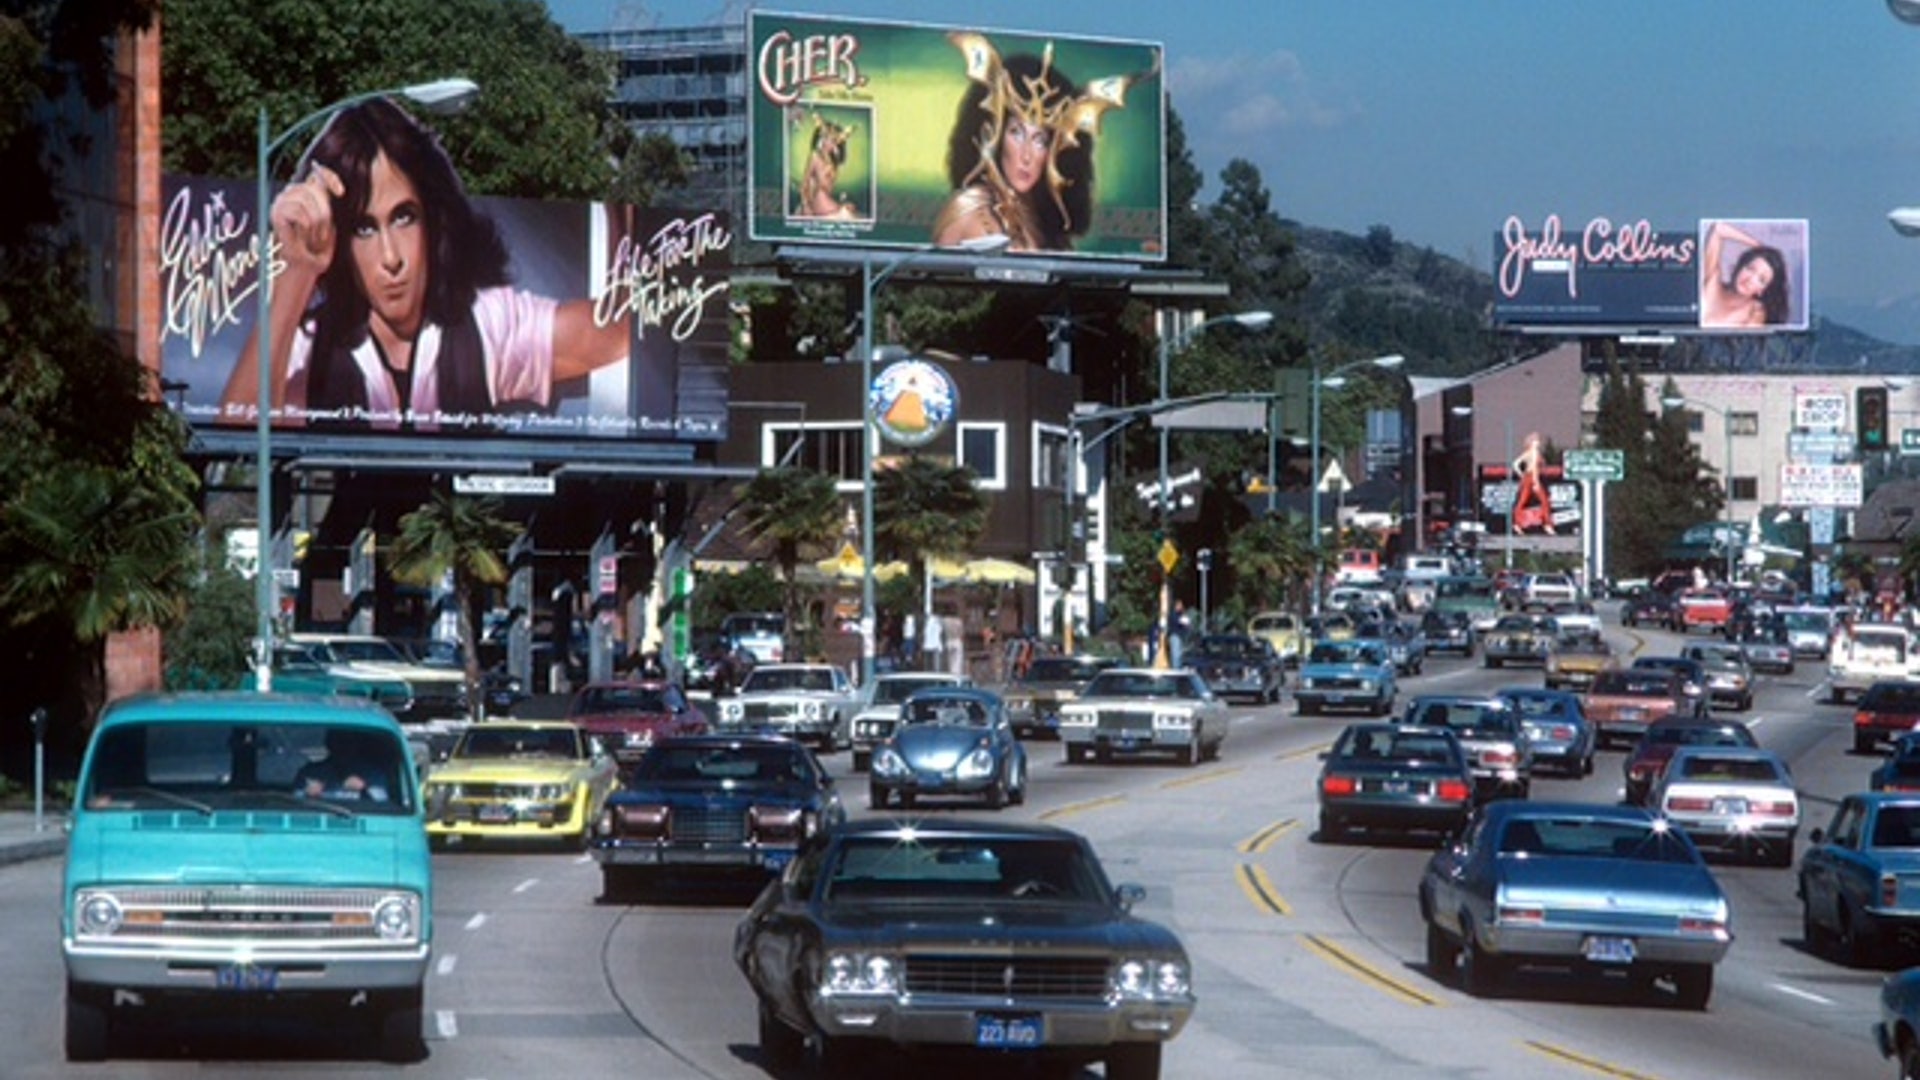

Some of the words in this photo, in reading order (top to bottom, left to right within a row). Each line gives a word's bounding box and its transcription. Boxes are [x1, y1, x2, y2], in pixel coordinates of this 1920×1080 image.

[160, 186, 249, 281] Eddie
[593, 234, 660, 328] Life
[684, 212, 731, 266] The
[1500, 215, 1577, 299] Judy
[1583, 218, 1696, 263] Collins
[614, 276, 731, 341] Taking
